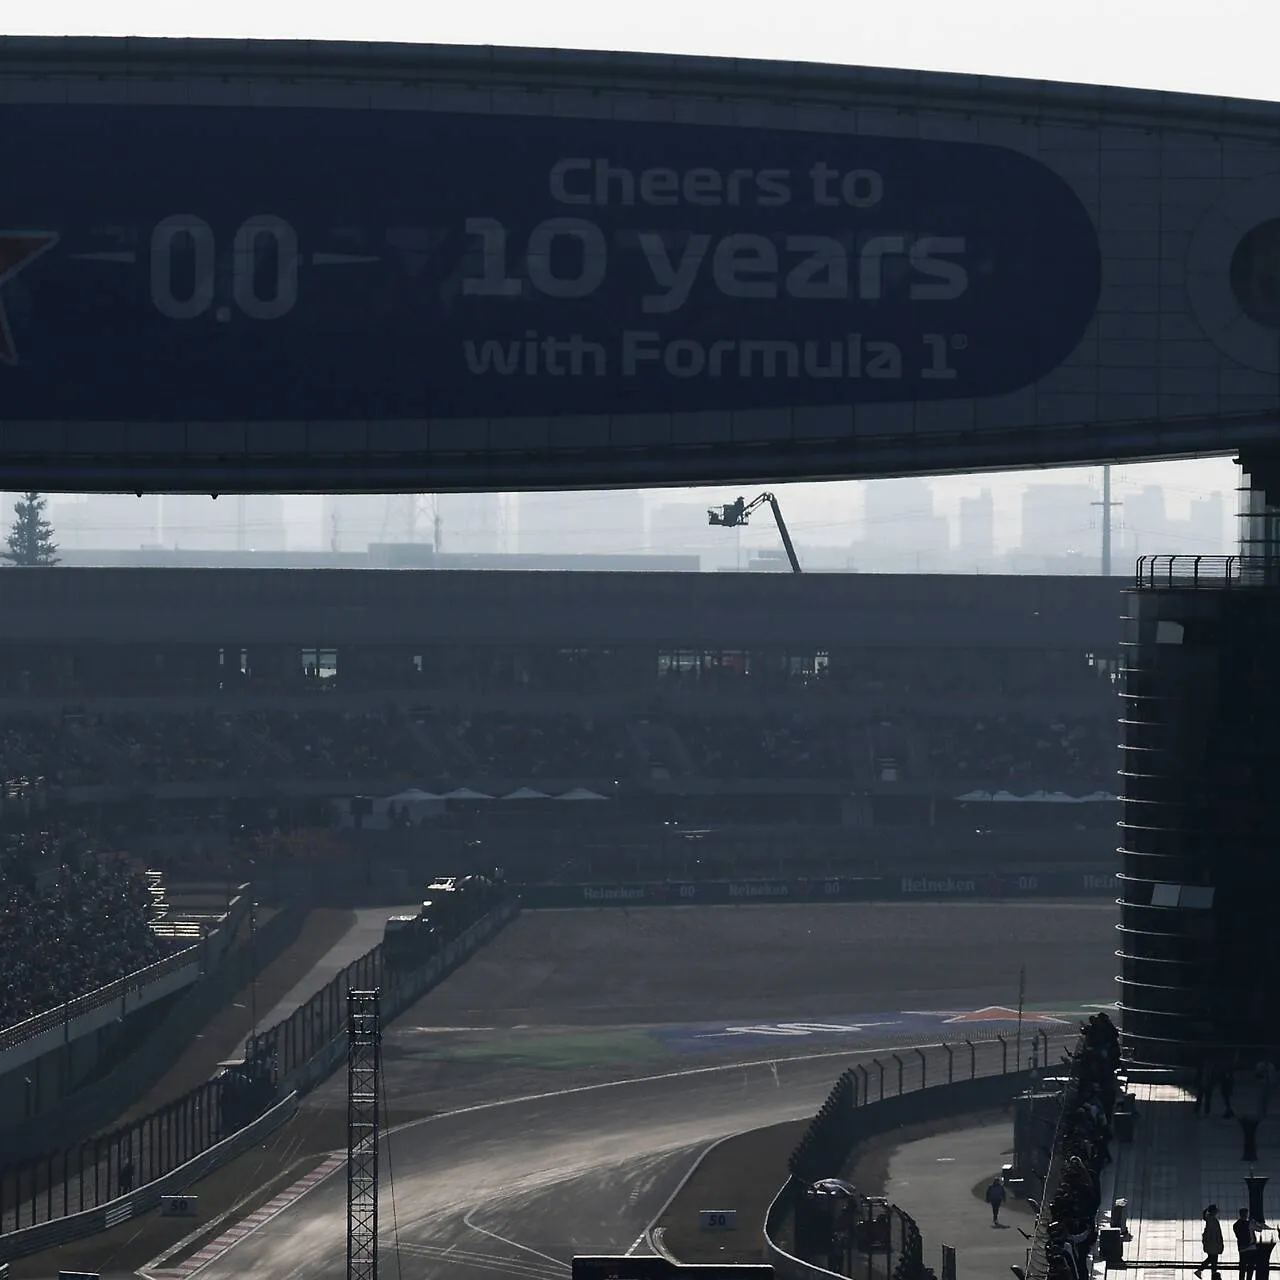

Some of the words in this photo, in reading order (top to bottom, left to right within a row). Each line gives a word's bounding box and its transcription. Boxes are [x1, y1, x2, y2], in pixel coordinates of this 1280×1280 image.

[548, 157, 793, 206] Cheers
[813, 166, 883, 206] to
[148, 213, 300, 323] 0.0
[460, 215, 609, 298] 10
[641, 230, 970, 315] years
[462, 331, 599, 378] with
[620, 330, 900, 380] Formula
[709, 1214, 726, 1226] 50
